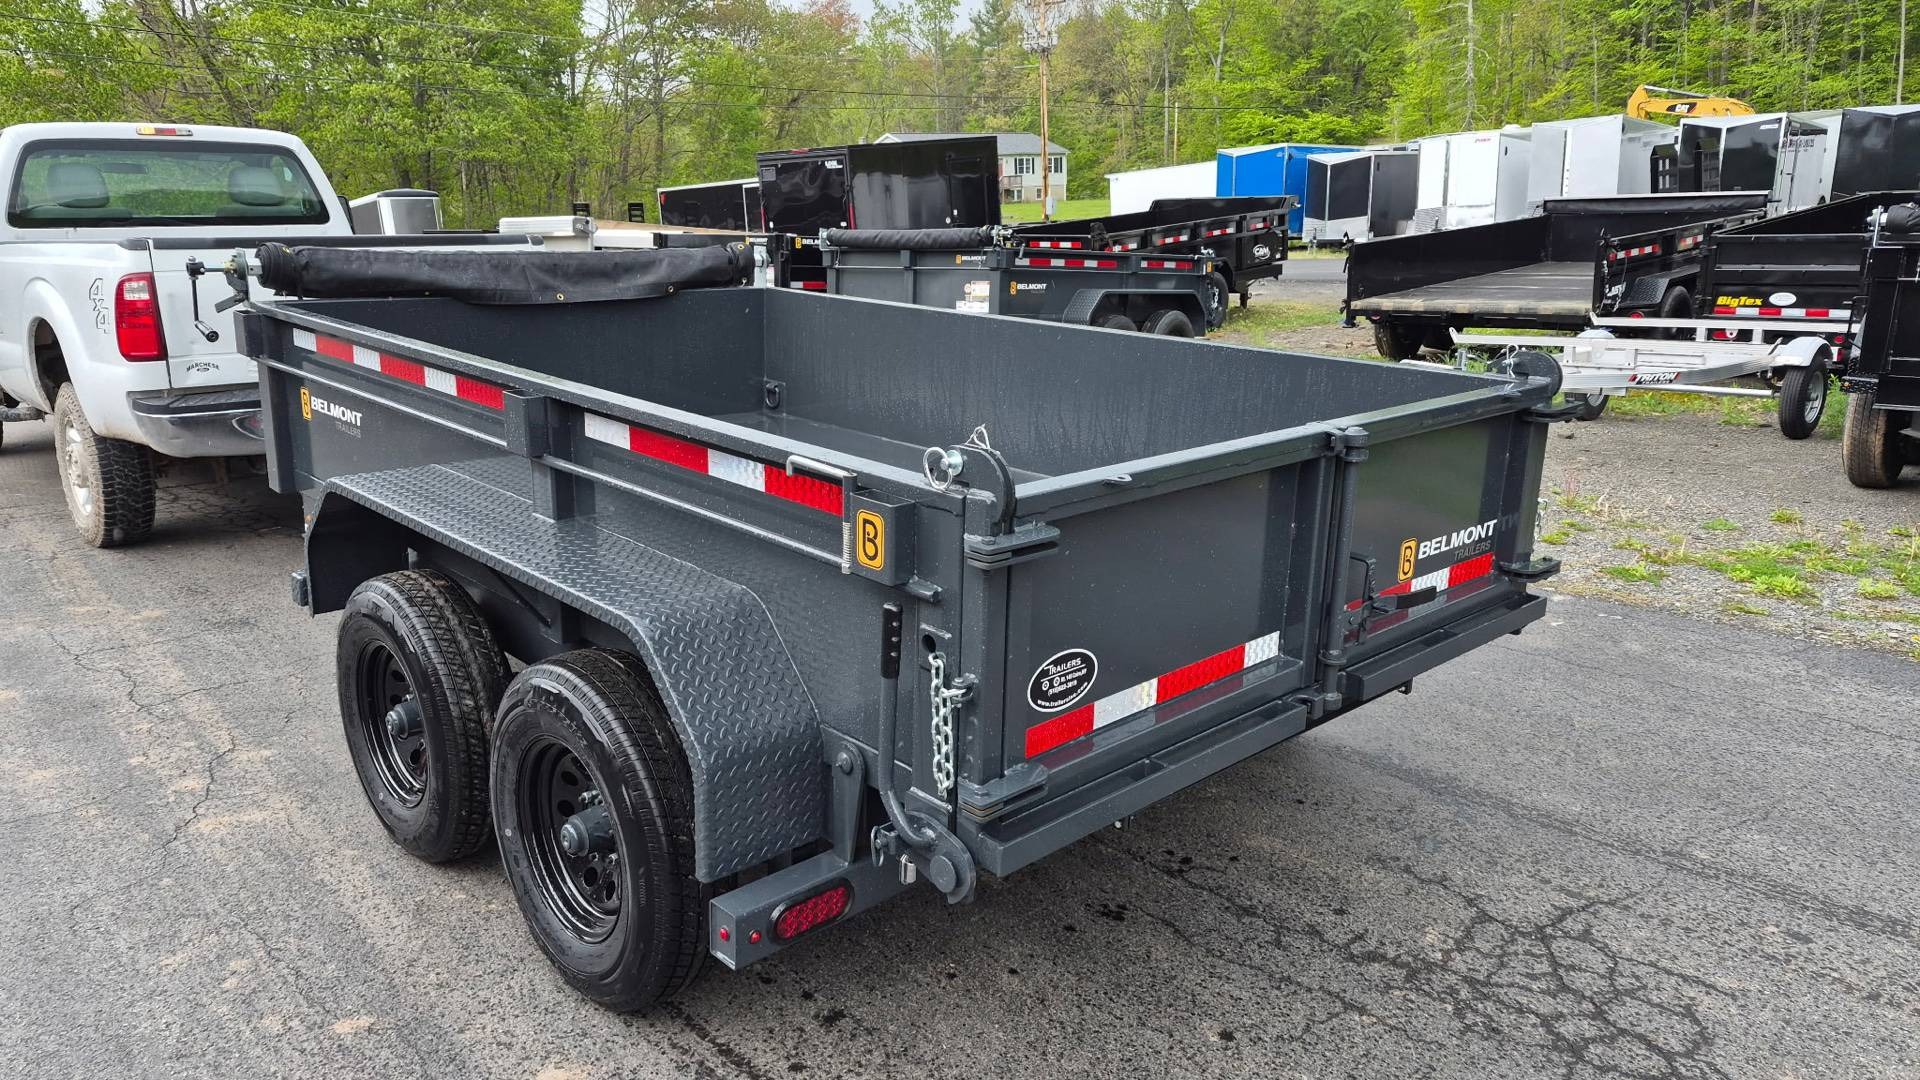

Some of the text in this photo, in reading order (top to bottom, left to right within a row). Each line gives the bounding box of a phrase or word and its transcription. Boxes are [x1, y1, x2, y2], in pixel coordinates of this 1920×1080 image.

[1675, 104, 1690, 113] CAT
[311, 396, 363, 427] BELMONT
[1418, 519, 1498, 560] BELMONT
[1453, 540, 1491, 561] TRAILERS
[1044, 657, 1082, 675] TRAILERS
